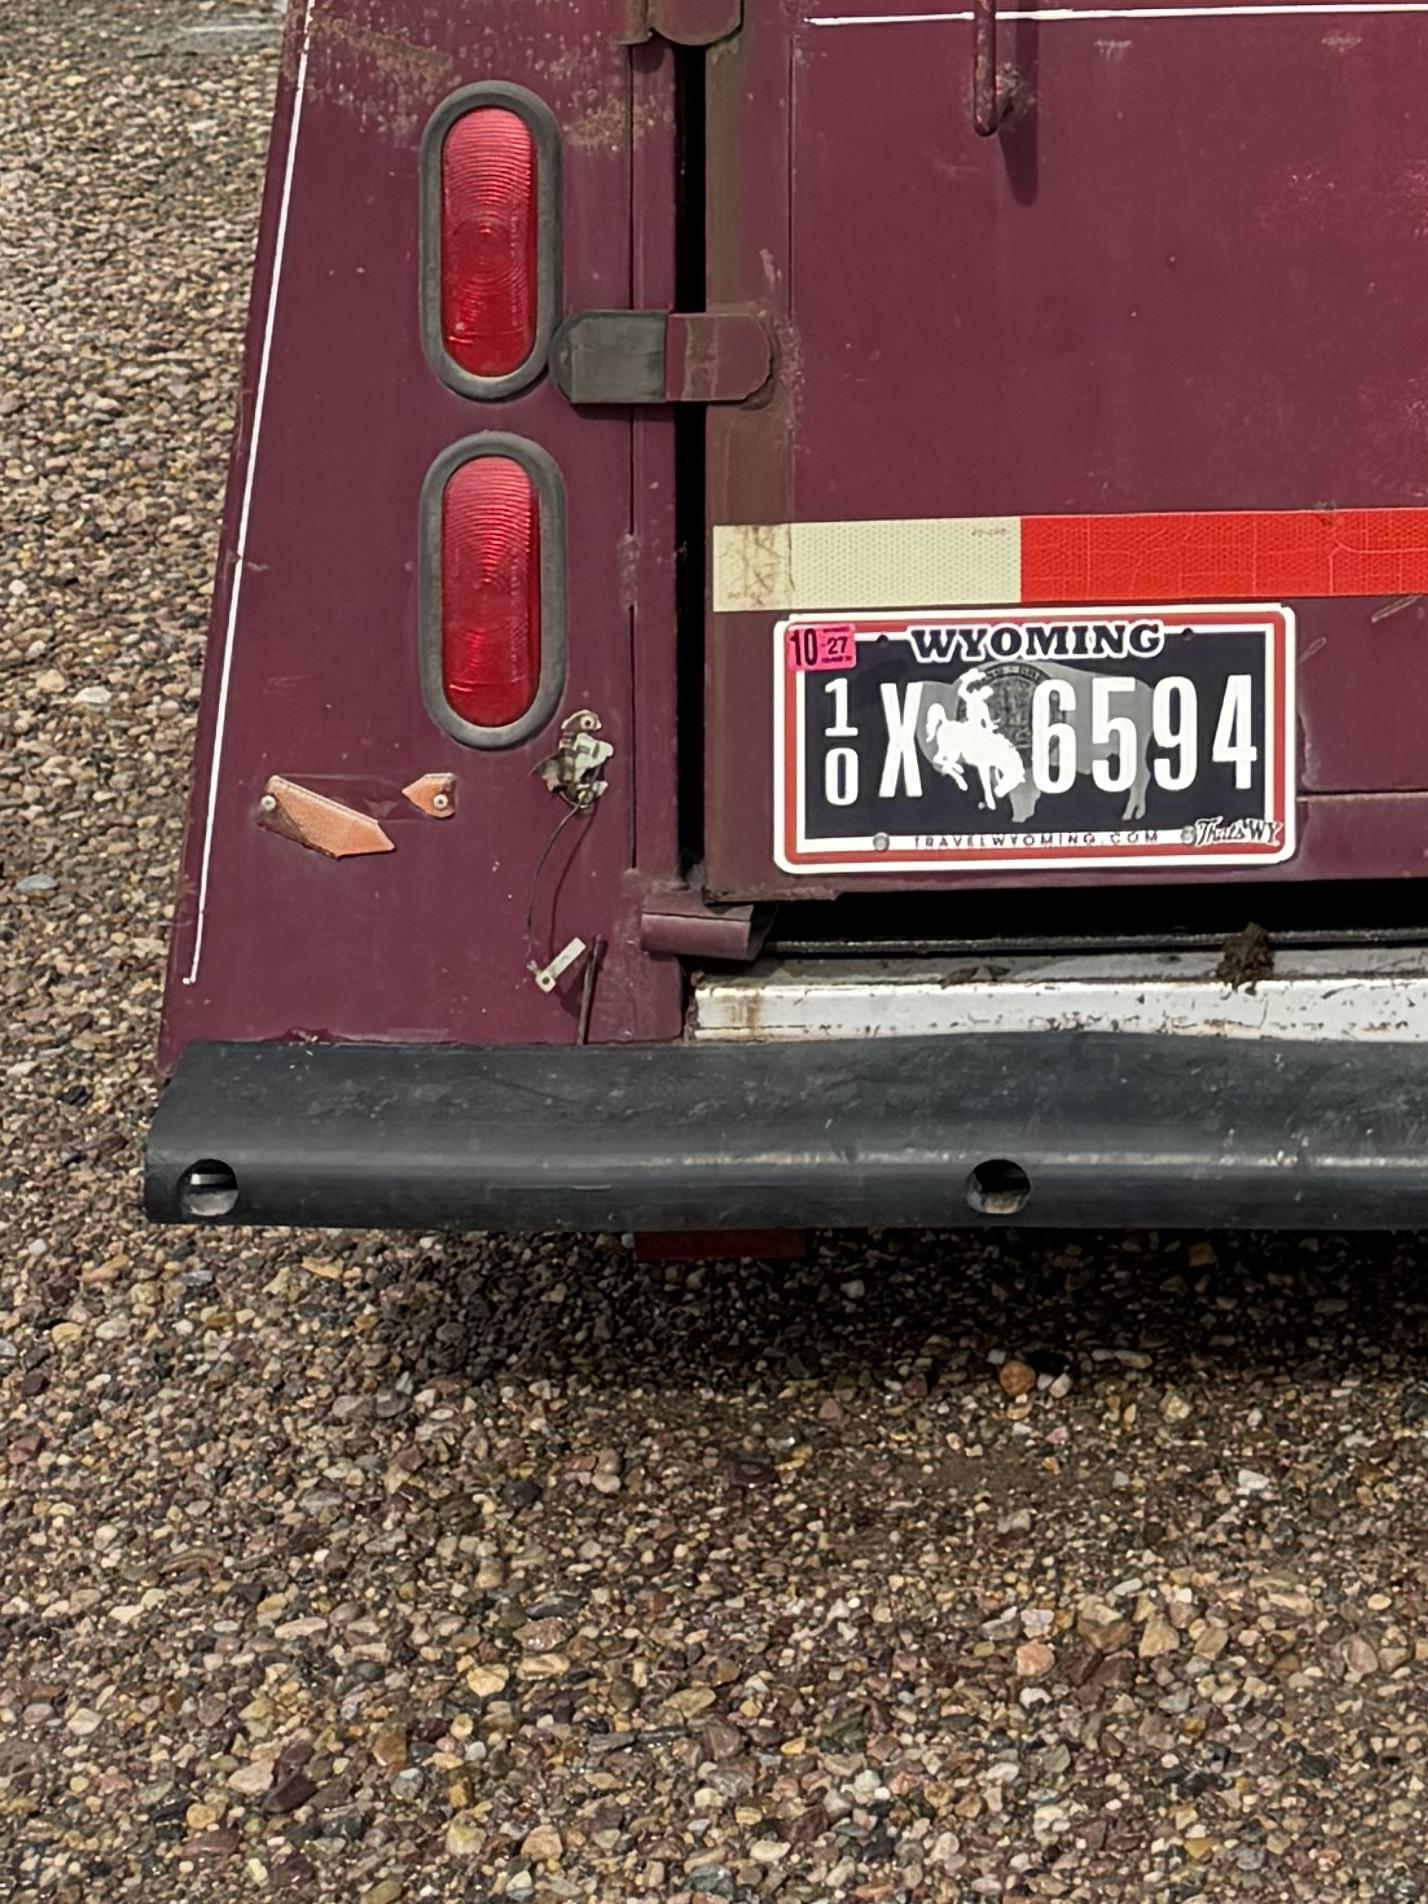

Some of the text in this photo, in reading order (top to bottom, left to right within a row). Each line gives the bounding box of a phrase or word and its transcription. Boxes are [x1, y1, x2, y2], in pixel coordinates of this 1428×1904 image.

[789, 628, 818, 666] 10
[907, 623, 1165, 662] WYOMING
[1031, 674, 1257, 795] 6594
[914, 831, 1160, 851] TRAVELWYOMING.COM
